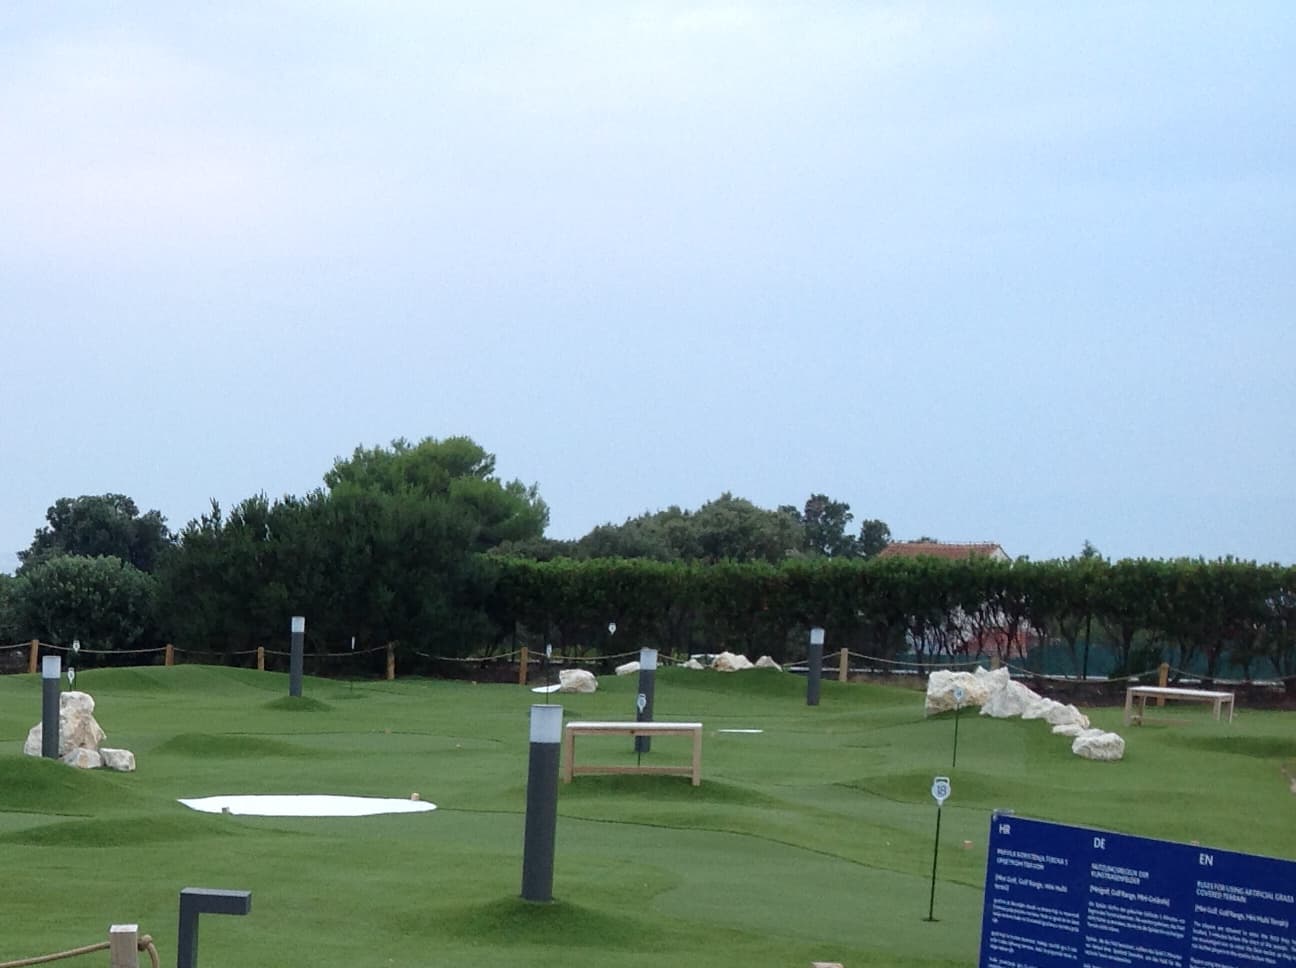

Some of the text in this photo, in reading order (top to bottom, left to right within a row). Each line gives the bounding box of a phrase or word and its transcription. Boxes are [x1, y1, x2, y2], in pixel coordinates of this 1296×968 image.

[998, 823, 1011, 835] HR
[1093, 837, 1106, 850] DE
[1199, 853, 1214, 867] EN
